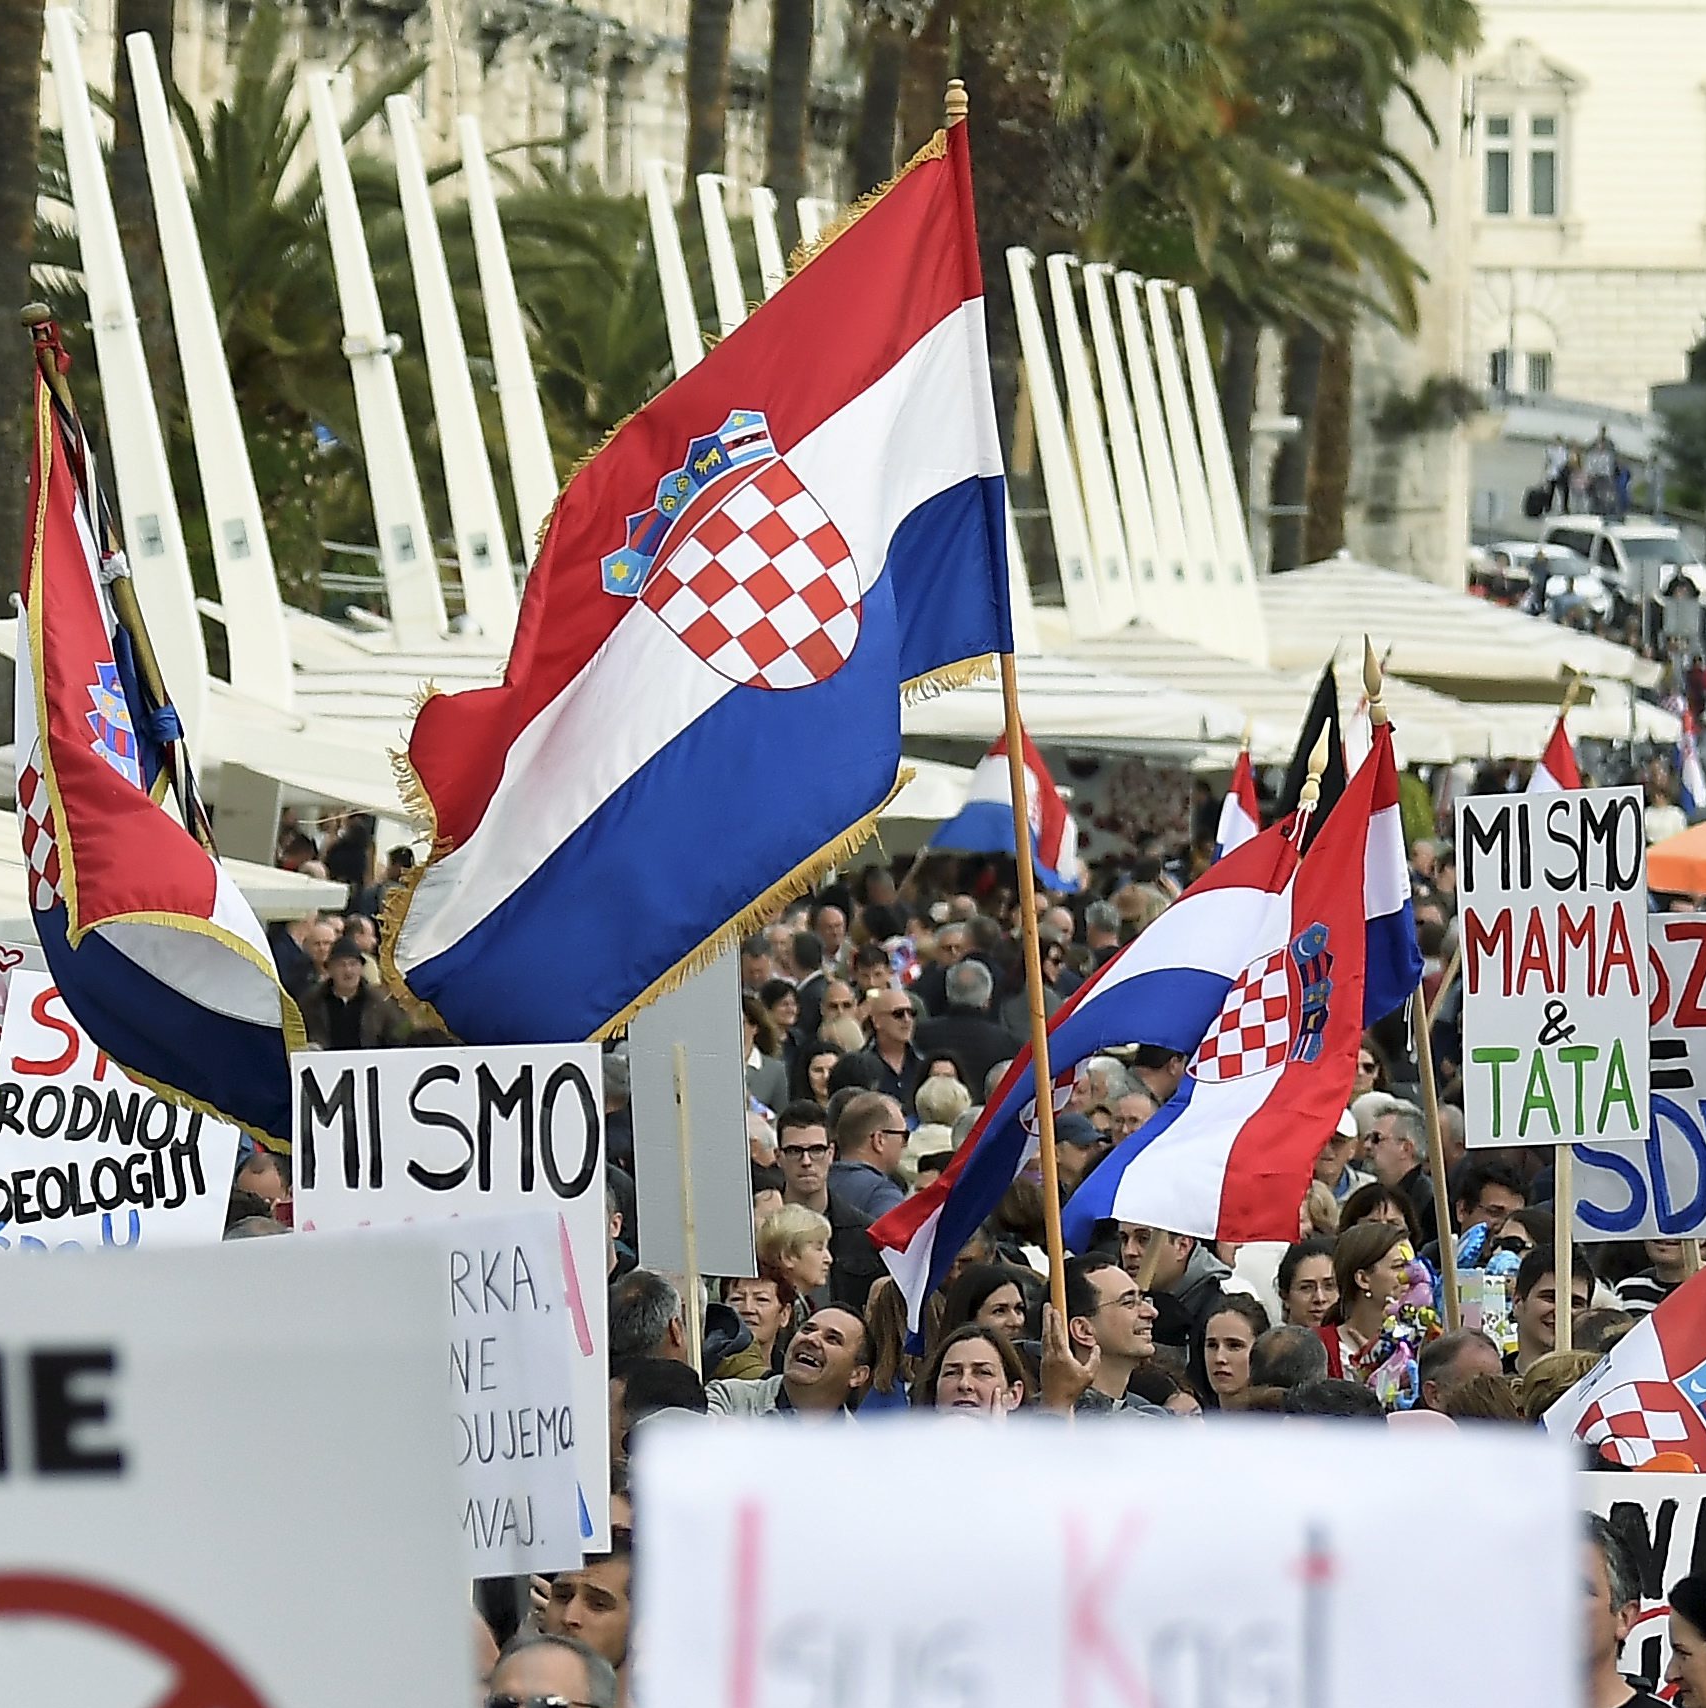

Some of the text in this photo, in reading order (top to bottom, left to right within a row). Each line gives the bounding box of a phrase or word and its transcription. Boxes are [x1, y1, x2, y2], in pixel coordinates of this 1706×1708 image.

[1462, 796, 1641, 892] MI SMO
[1465, 901, 1642, 997] MAMA
[1538, 1001, 1576, 1046] &
[299, 1061, 601, 1199] MI SMO
[1471, 1038, 1641, 1138] TATA
